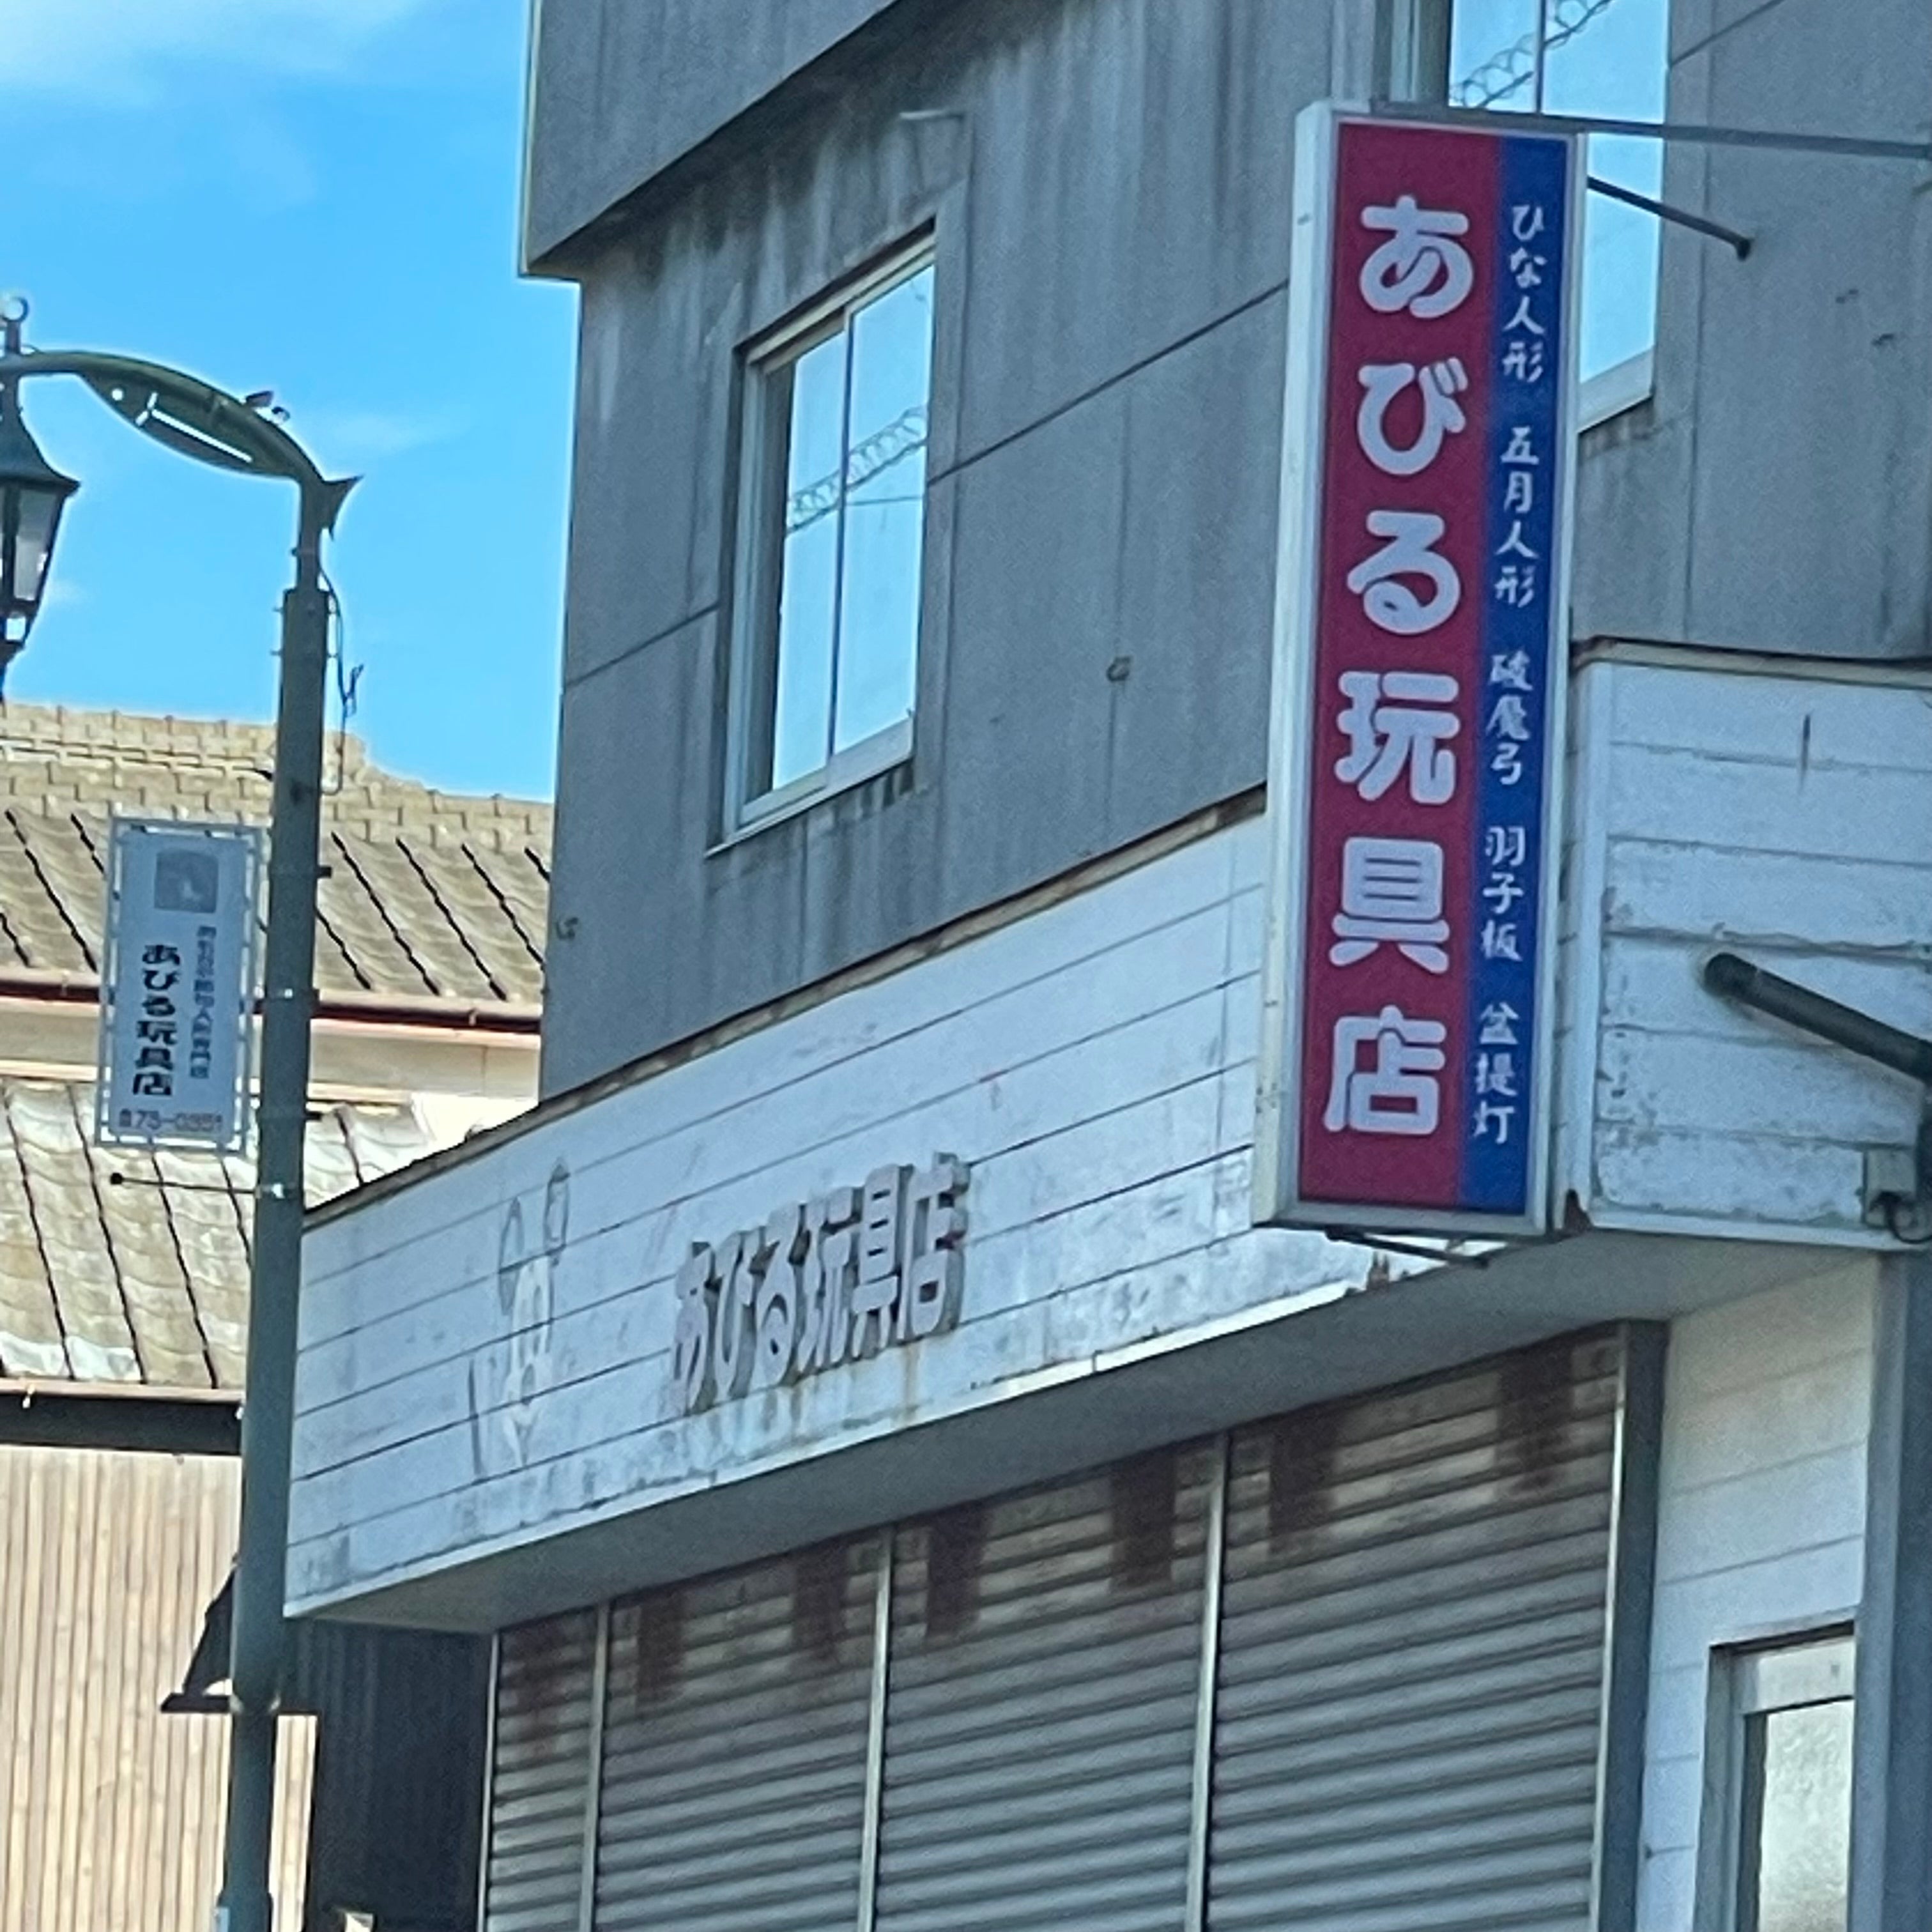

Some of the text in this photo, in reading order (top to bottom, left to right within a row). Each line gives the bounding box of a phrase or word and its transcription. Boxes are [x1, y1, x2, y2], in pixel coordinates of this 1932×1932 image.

[1323, 194, 1475, 1136] あびる玩具店
[1472, 206, 1544, 1143] ひな人形 五月人形 破魔弓 羽子板 盆提灯
[132, 944, 181, 1096] あびる玩具店
[671, 1153, 969, 1414] あびる玩具店
